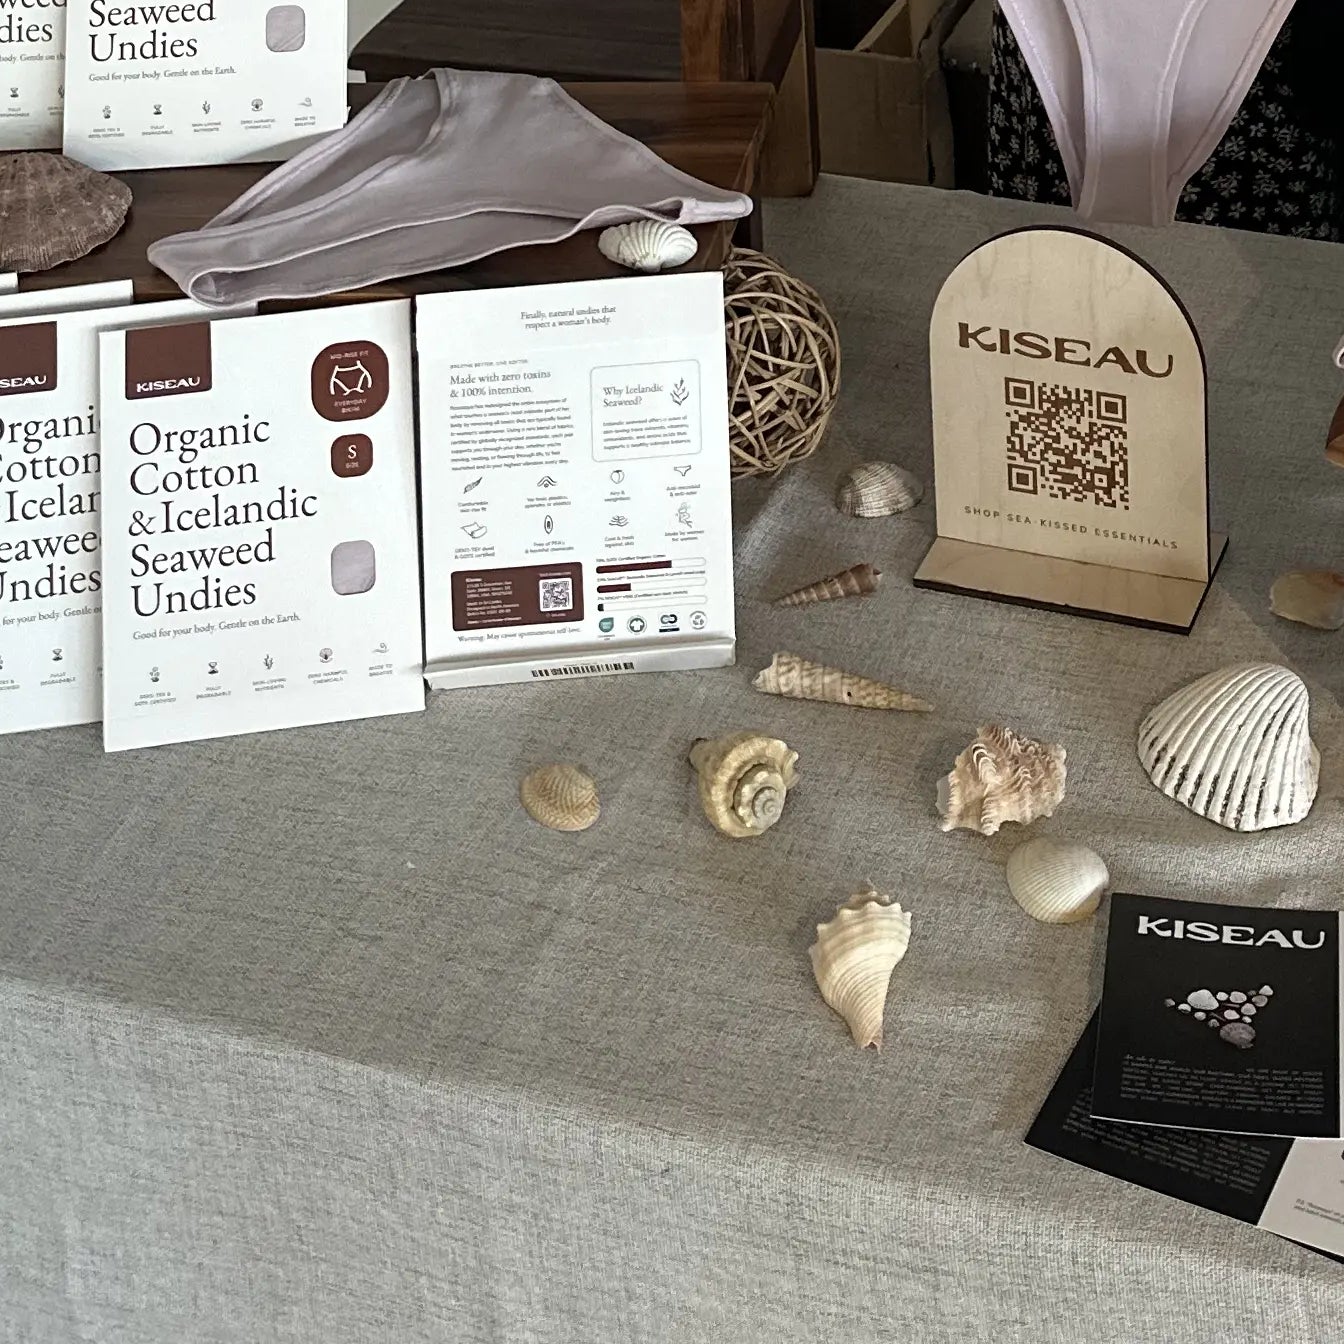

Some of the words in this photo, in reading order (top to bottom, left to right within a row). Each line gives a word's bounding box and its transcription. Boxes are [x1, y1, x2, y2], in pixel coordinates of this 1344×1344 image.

[88, 29, 197, 62] Undies
[957, 321, 1174, 379] KISEAU
[136, 376, 200, 393] KISEAU
[450, 374, 477, 385] Made
[478, 372, 499, 384] with
[499, 372, 521, 383] zero
[450, 388, 459, 399] &
[461, 386, 487, 398] 100%
[603, 385, 624, 397] Why
[625, 382, 664, 396] Icelandic
[603, 395, 643, 409] Seaweed?
[0, 405, 101, 454] rgani
[129, 414, 270, 464] Organic
[0, 450, 101, 484] otton
[347, 444, 357, 459] S
[130, 462, 259, 496] Cotton
[964, 505, 1000, 519] SHOP
[1094, 527, 1178, 550] ESSENTIALS
[0, 530, 102, 565] eawee
[131, 527, 276, 577] Seaweed
[130, 575, 256, 617] Undies
[132, 629, 158, 641] Good
[158, 627, 172, 638] for
[172, 627, 193, 639] your
[218, 619, 247, 631] Gentle
[248, 619, 260, 627] on
[261, 615, 276, 625] the
[276, 612, 301, 624] Earth.
[1136, 914, 1326, 950] KISEAU
